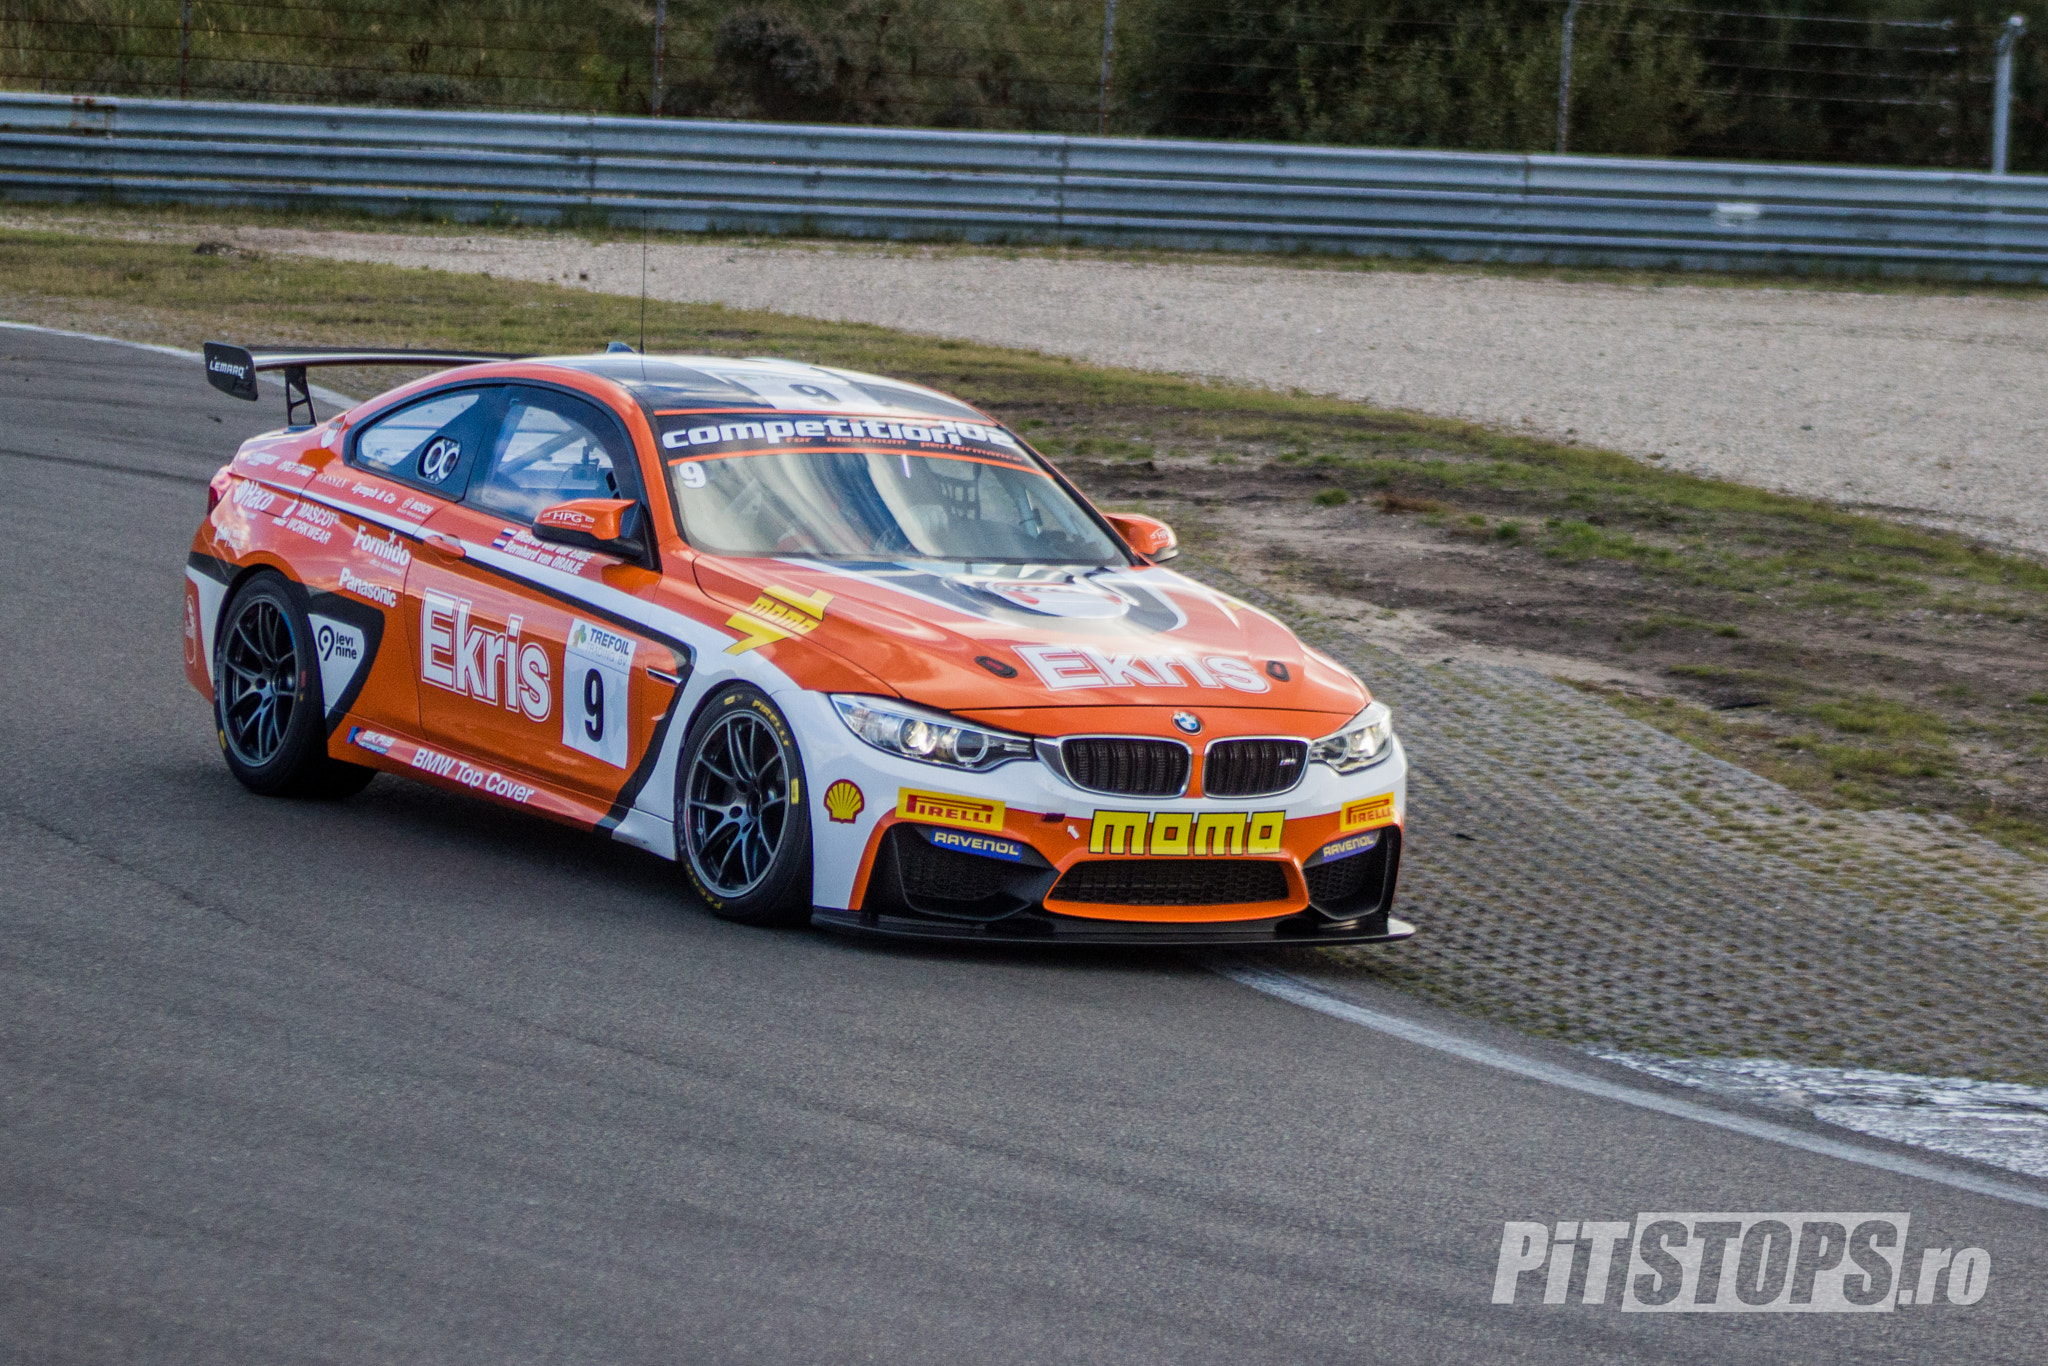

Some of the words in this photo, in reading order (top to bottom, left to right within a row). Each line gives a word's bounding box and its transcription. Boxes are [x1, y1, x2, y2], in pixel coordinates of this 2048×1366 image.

[209, 360, 245, 380] LEMARQ
[827, 436, 907, 445] maximum
[920, 441, 1024, 462] performance
[679, 461, 706, 489] 9
[296, 502, 335, 528] MASCOT
[410, 501, 434, 515] BOSCH
[552, 511, 582, 523] HPG
[286, 517, 332, 545] WORKWEAR
[353, 524, 411, 566] Formido
[503, 540, 541, 560] Bernhard
[536, 552, 554, 565] van
[550, 555, 585, 575] ORANJE
[338, 567, 397, 608] Panasonic
[745, 595, 820, 635] momo
[335, 646, 357, 659] nine
[336, 632, 354, 647] levi
[589, 628, 629, 656] TREFOIL
[421, 587, 551, 724] Ekris
[1011, 643, 1271, 693] Ekris
[584, 668, 604, 742] 9
[411, 747, 457, 777] BMW
[455, 761, 484, 788] Top
[485, 772, 535, 803] Cover
[906, 794, 994, 824] PIRELLI
[1347, 799, 1391, 825] PIRELLI
[934, 832, 1020, 856] RAVENOL
[1089, 809, 1286, 856] momo
[1322, 835, 1375, 858] RAVENOL
